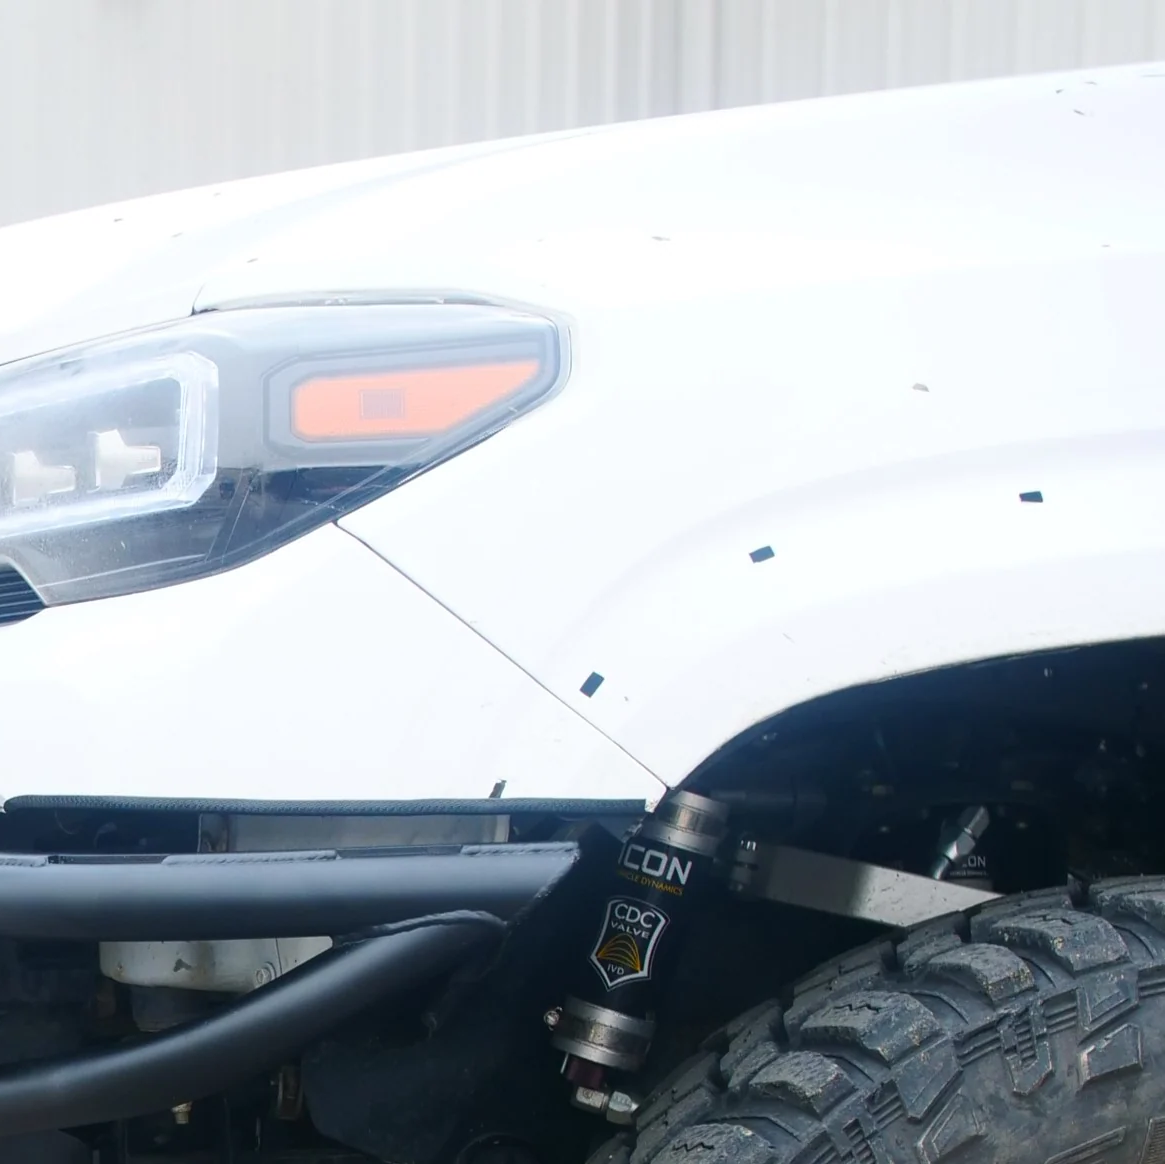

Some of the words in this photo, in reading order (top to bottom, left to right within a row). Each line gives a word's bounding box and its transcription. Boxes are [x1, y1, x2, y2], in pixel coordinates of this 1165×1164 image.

[640, 876, 684, 896] DYNAMICS
[615, 903, 655, 928] CDC
[611, 921, 651, 939] VALVE
[607, 964, 625, 975] IVD
